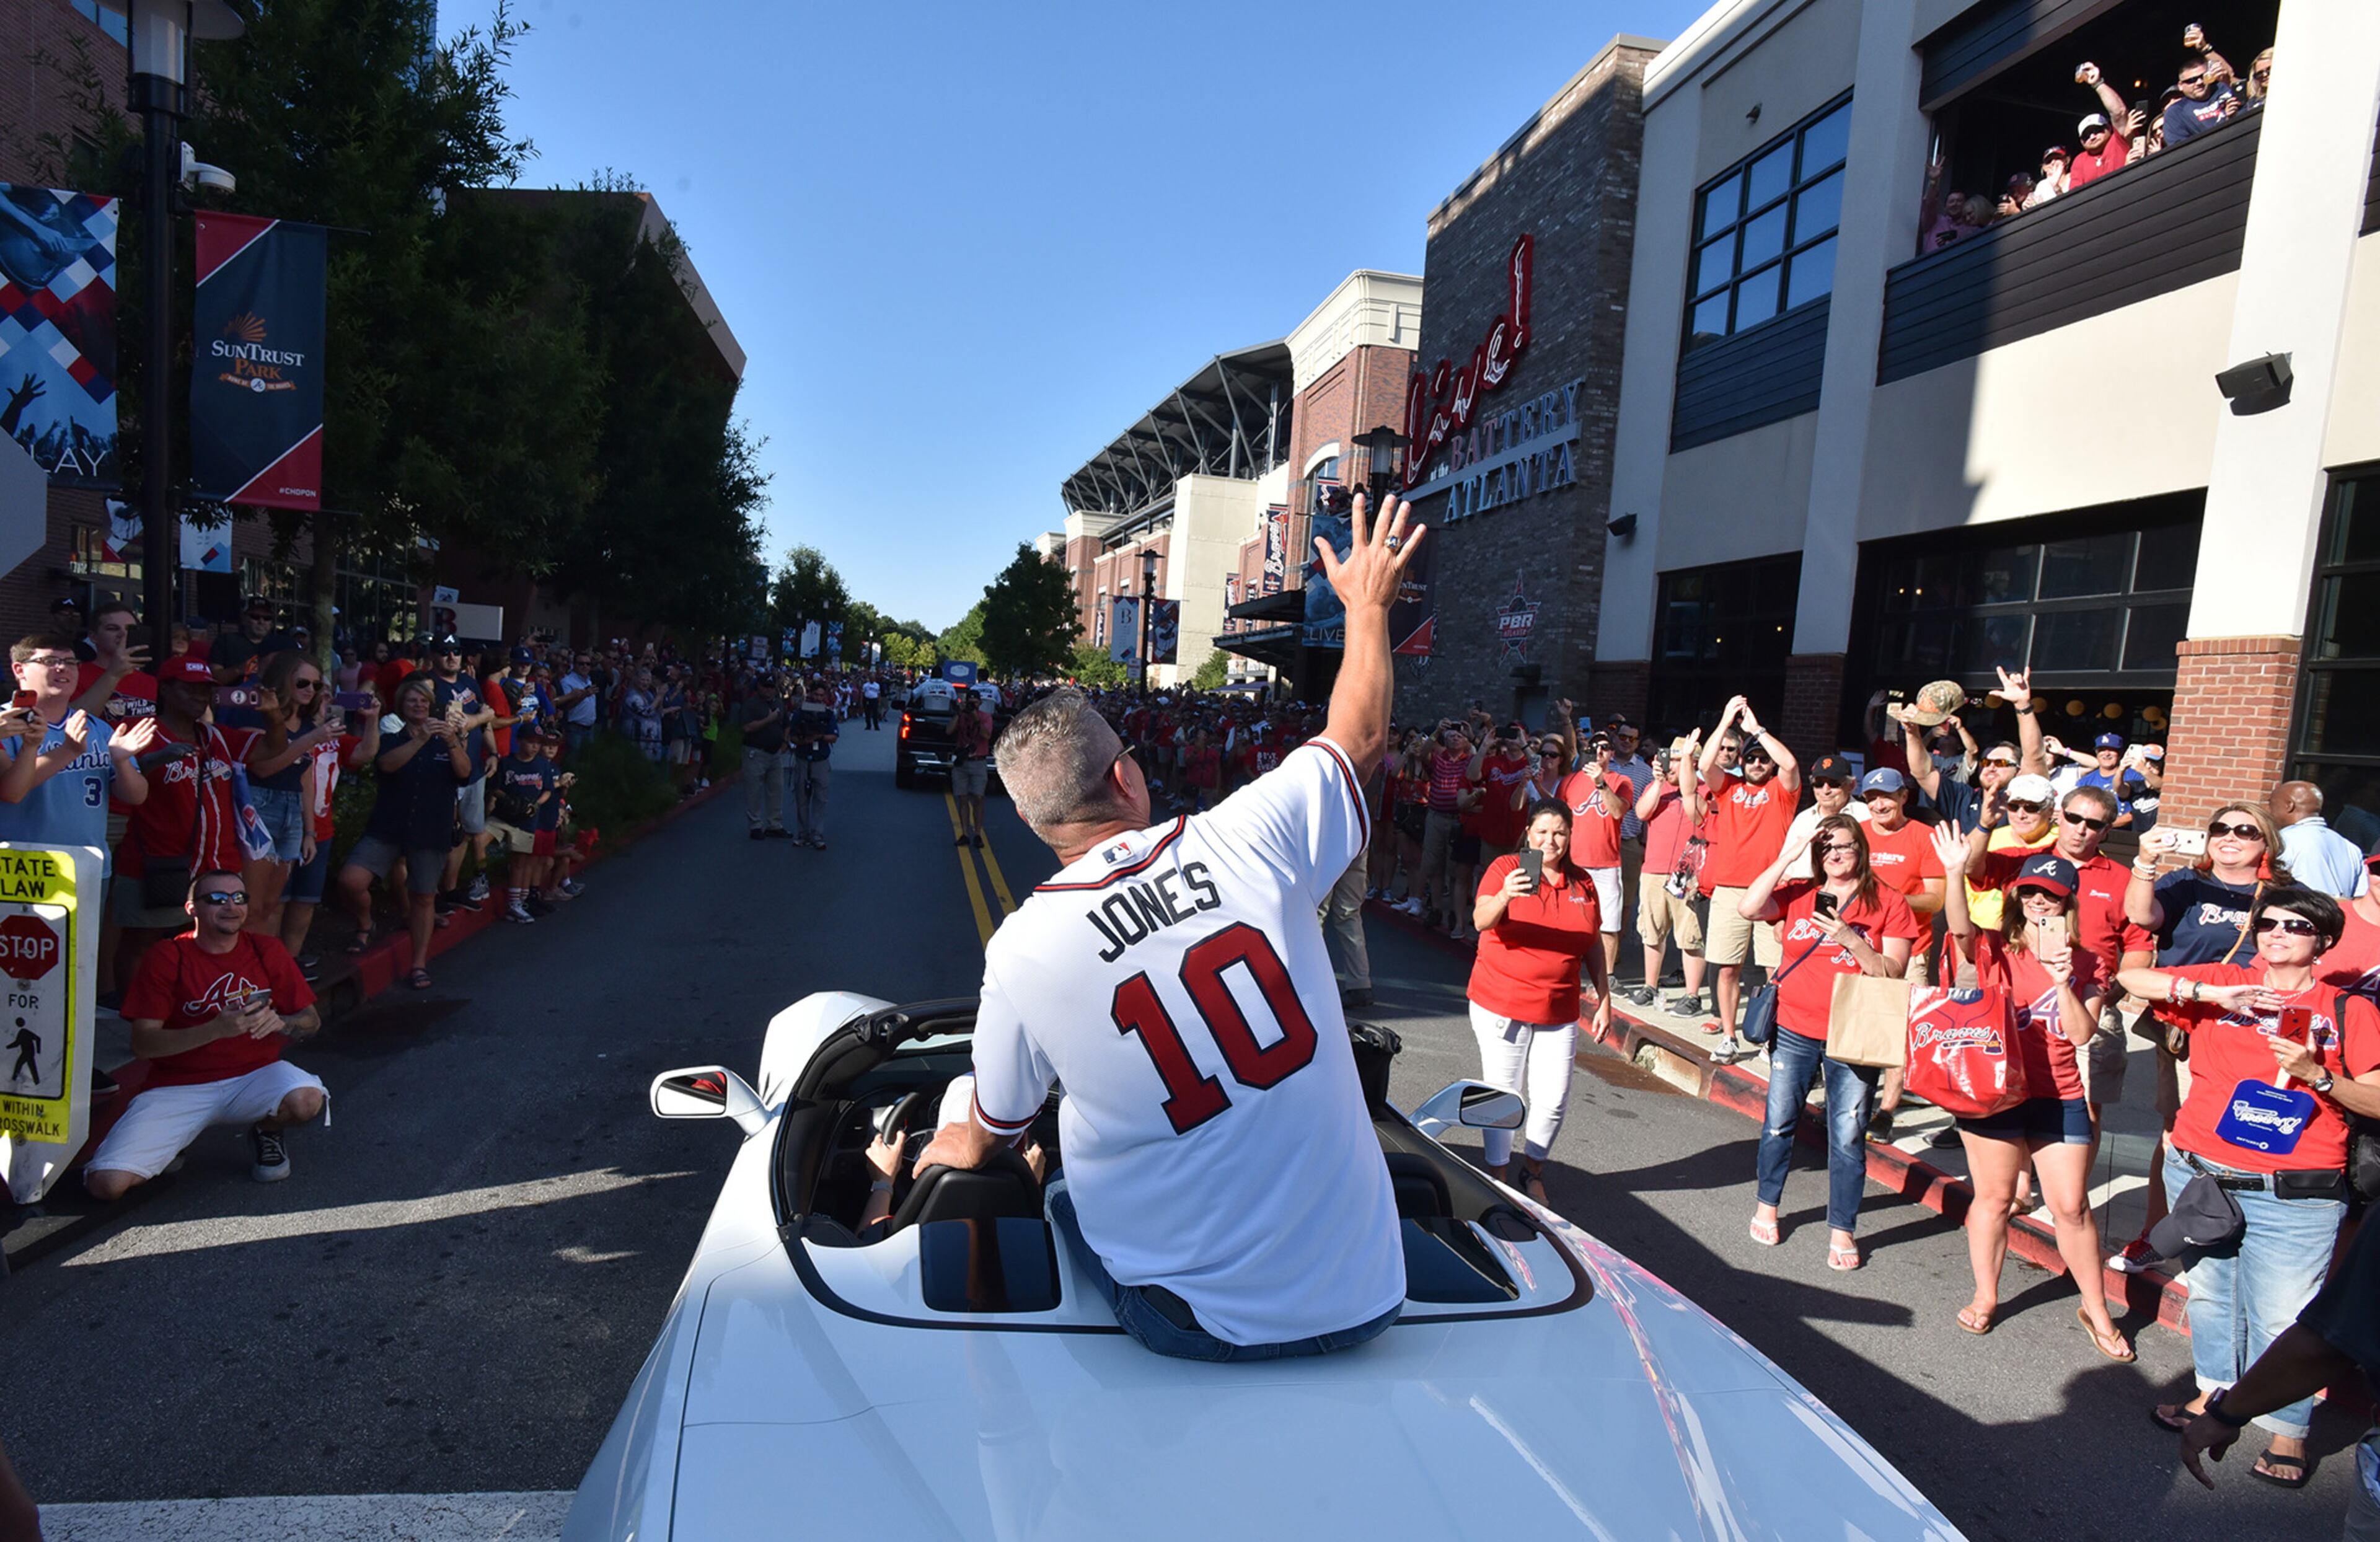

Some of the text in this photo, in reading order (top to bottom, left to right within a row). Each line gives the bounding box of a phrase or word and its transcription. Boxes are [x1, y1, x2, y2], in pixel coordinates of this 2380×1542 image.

[211, 340, 305, 367] SUNTRUST
[235, 357, 281, 379] PARK
[1450, 377, 1587, 473] BATTERY
[20, 444, 107, 477] LAY
[1443, 439, 1577, 523] ATLANTA
[280, 487, 316, 497] #CHOPON
[1499, 614, 1534, 630] PBR
[1308, 628, 1345, 643] LIVE
[126, 699, 148, 710] WILD
[131, 705, 156, 716] THING
[84, 776, 102, 807] 3
[0, 857, 56, 877] TATE
[1, 879, 45, 898] LAW
[1086, 861, 1221, 963] JONES
[0, 935, 55, 960] STOP
[9, 993, 39, 1010] FOR
[1111, 921, 1318, 1135] 10
[1914, 1022, 1991, 1051] Braves
[3, 1100, 44, 1116] WITHIN
[0, 1116, 60, 1136] OSSWALK
